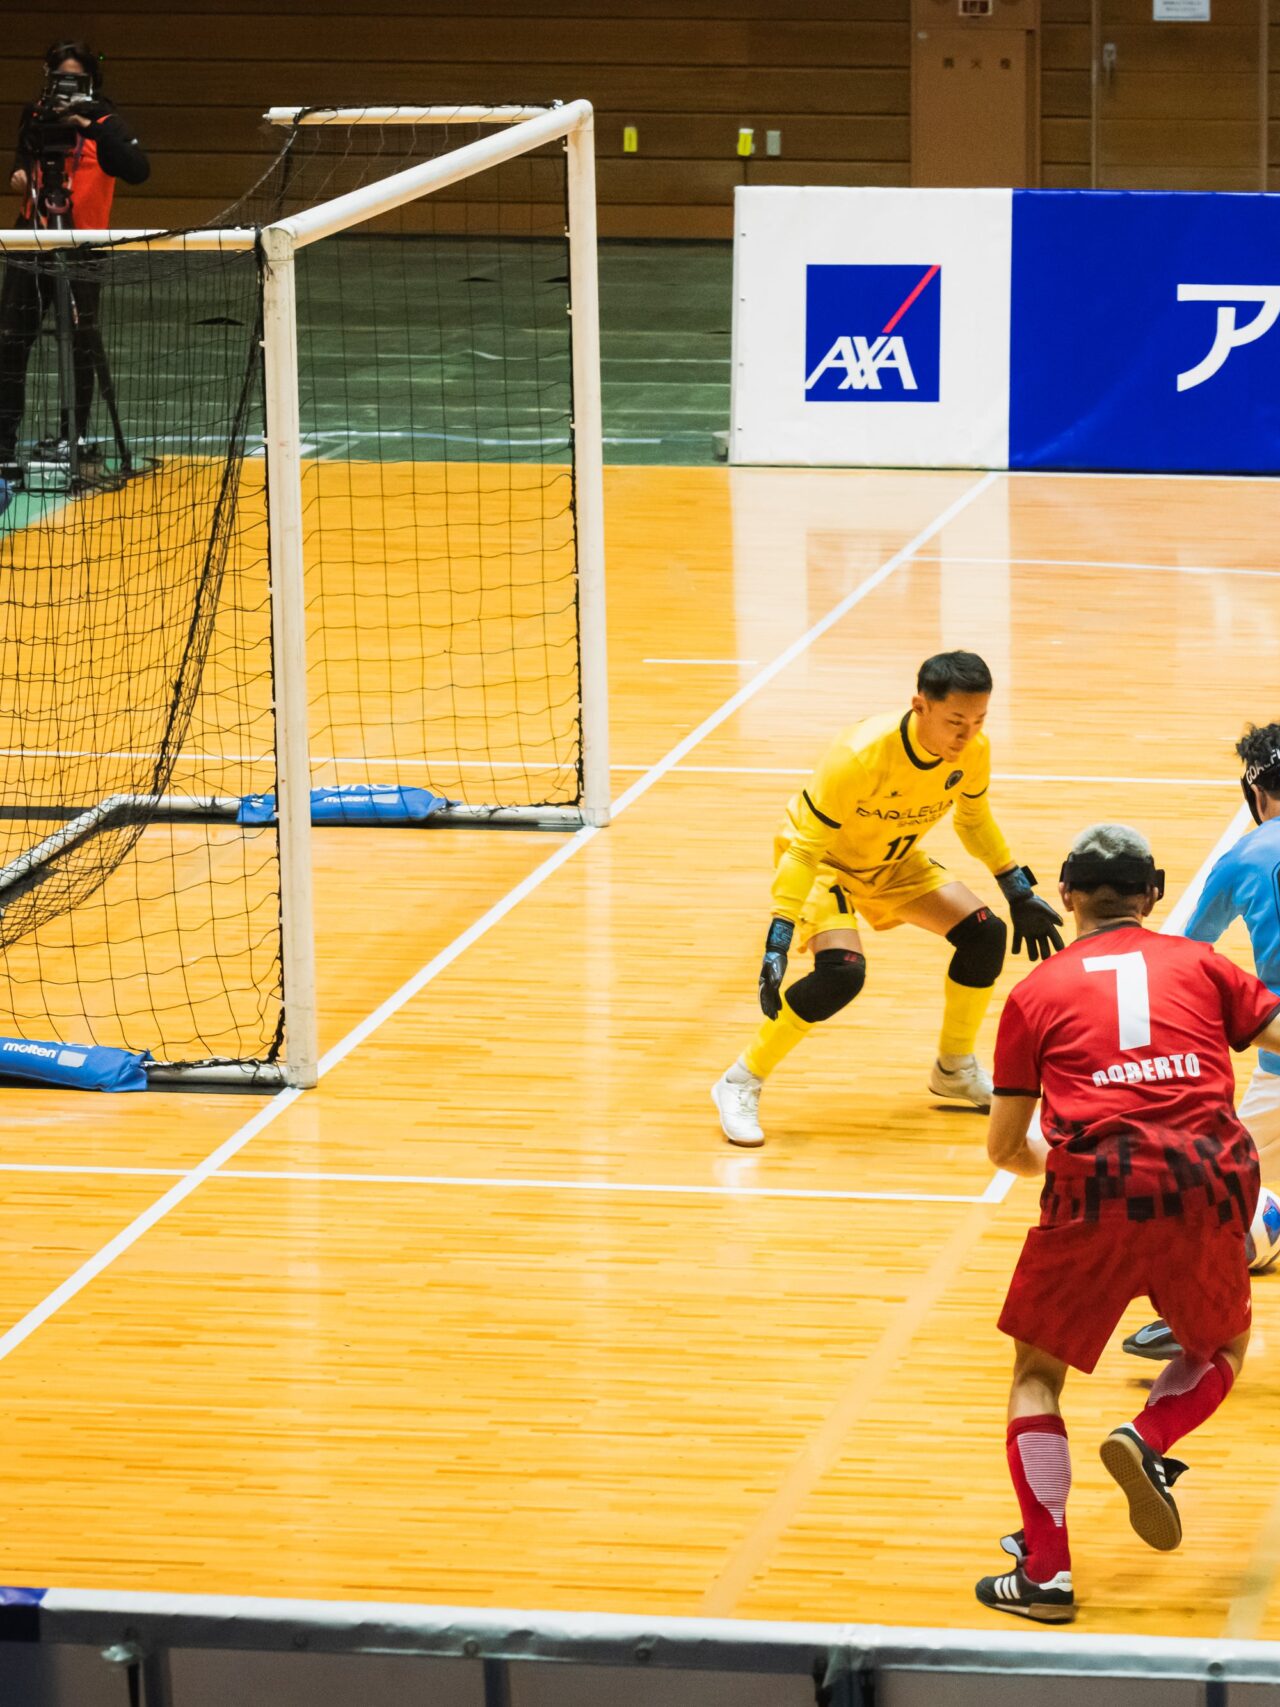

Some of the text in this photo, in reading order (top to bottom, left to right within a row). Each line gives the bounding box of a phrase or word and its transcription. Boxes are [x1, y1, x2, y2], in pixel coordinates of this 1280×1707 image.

[805, 335, 919, 390] AXA
[1081, 951, 1151, 1051] 7
[3, 1042, 57, 1059] molten
